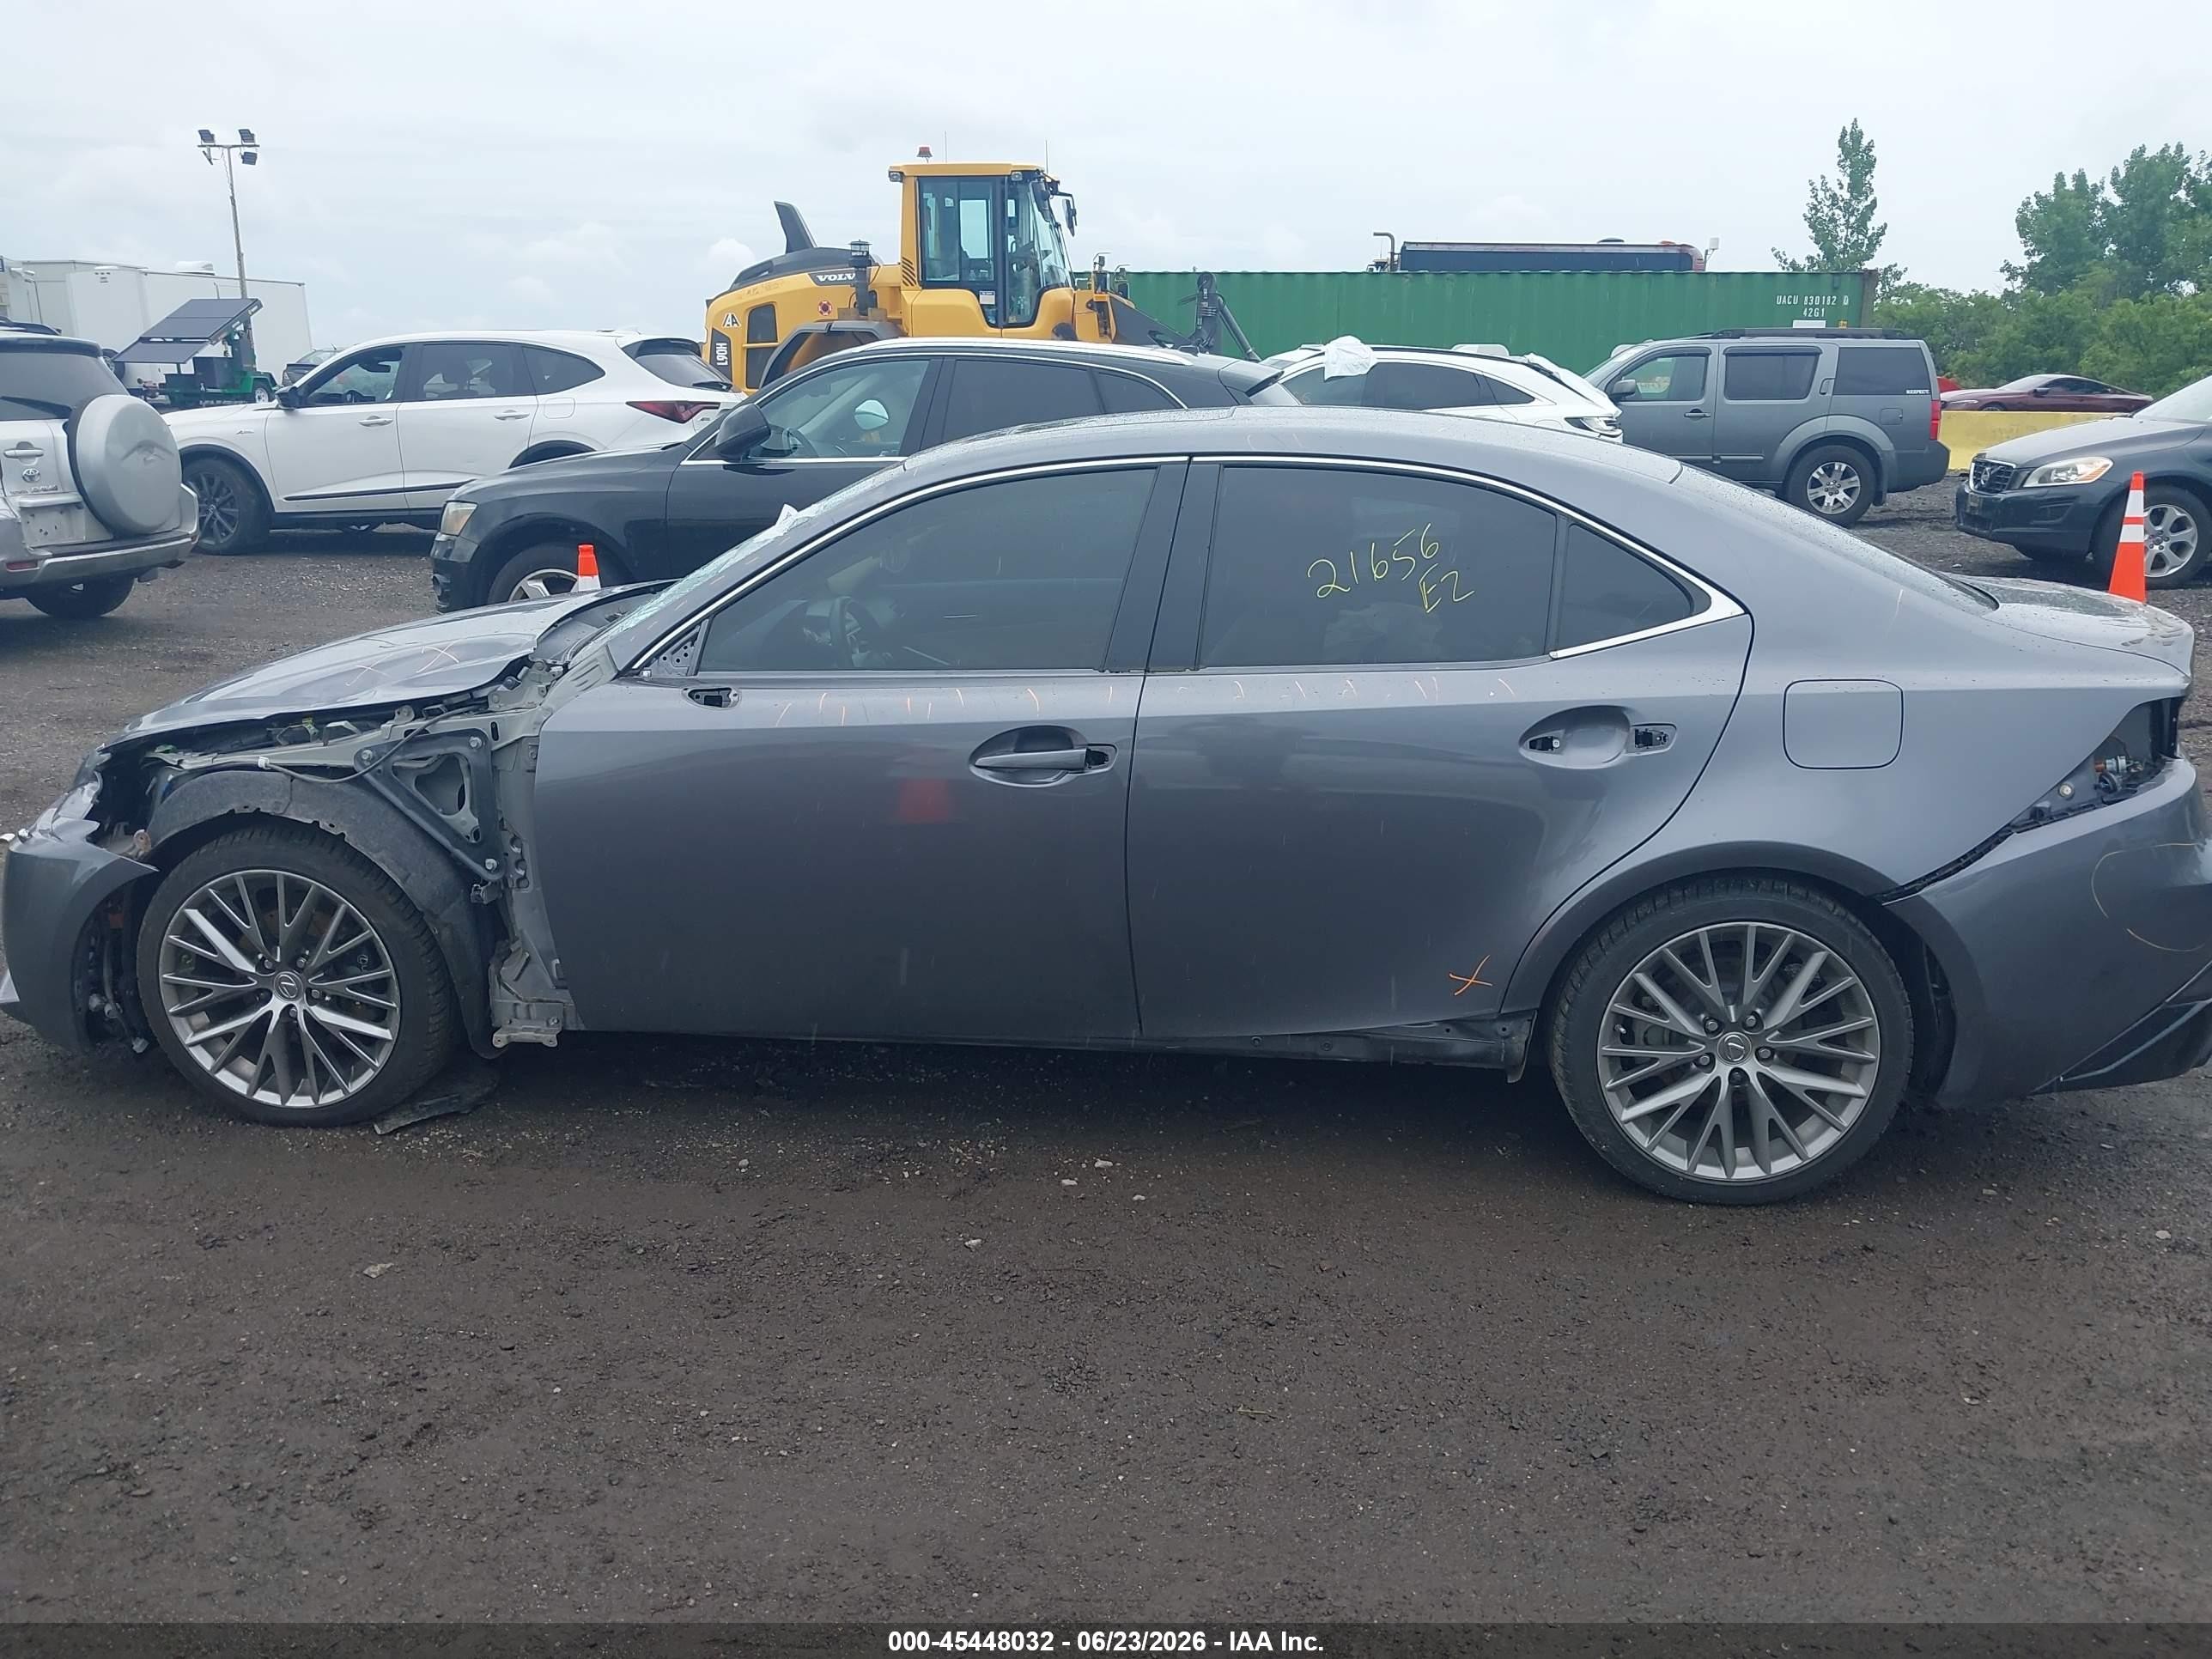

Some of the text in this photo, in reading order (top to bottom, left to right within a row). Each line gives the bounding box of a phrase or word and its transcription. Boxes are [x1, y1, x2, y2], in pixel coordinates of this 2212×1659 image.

[817, 273, 856, 282] VOLV
[1776, 295, 1799, 305] UACU
[1803, 295, 1837, 306] 830182
[1802, 307, 1826, 318] 42G1
[715, 343, 729, 366] L90H
[1307, 522, 1440, 599] 21656
